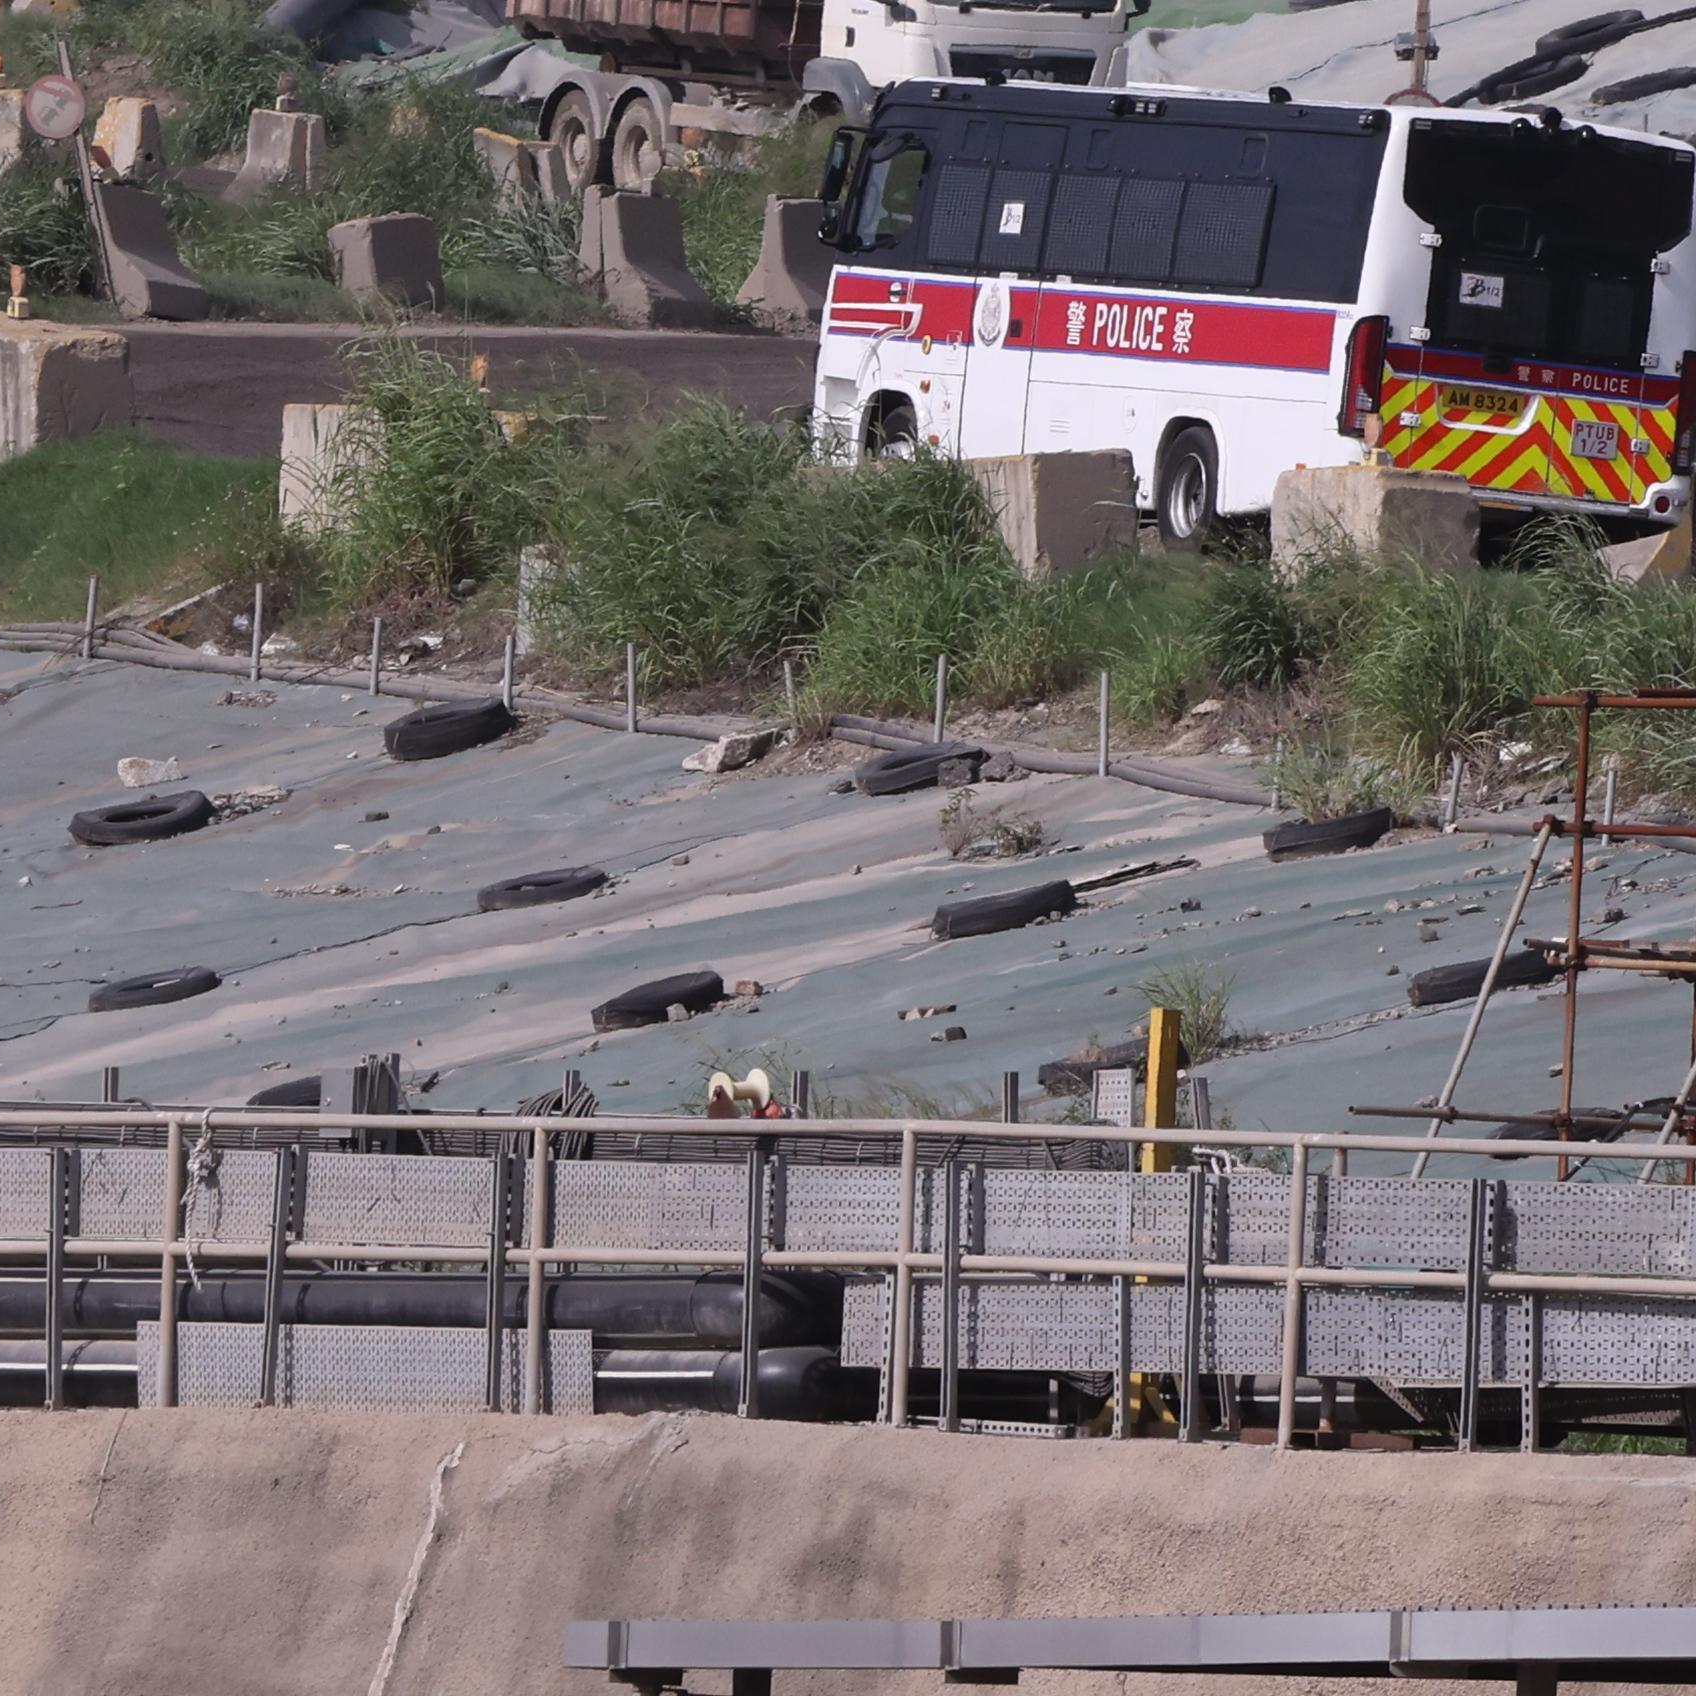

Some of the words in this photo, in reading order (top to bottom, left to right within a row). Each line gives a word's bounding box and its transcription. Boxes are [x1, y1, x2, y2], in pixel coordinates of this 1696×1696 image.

[1066, 301, 1086, 345] 警
[1092, 303, 1168, 351] POLICE
[1172, 308, 1194, 354] 察
[1572, 372, 1630, 394] POLICE
[1448, 390, 1471, 408] AM
[1474, 395, 1519, 413] 8324
[1576, 423, 1615, 441] PTUB
[1581, 439, 1608, 455] 1/2
